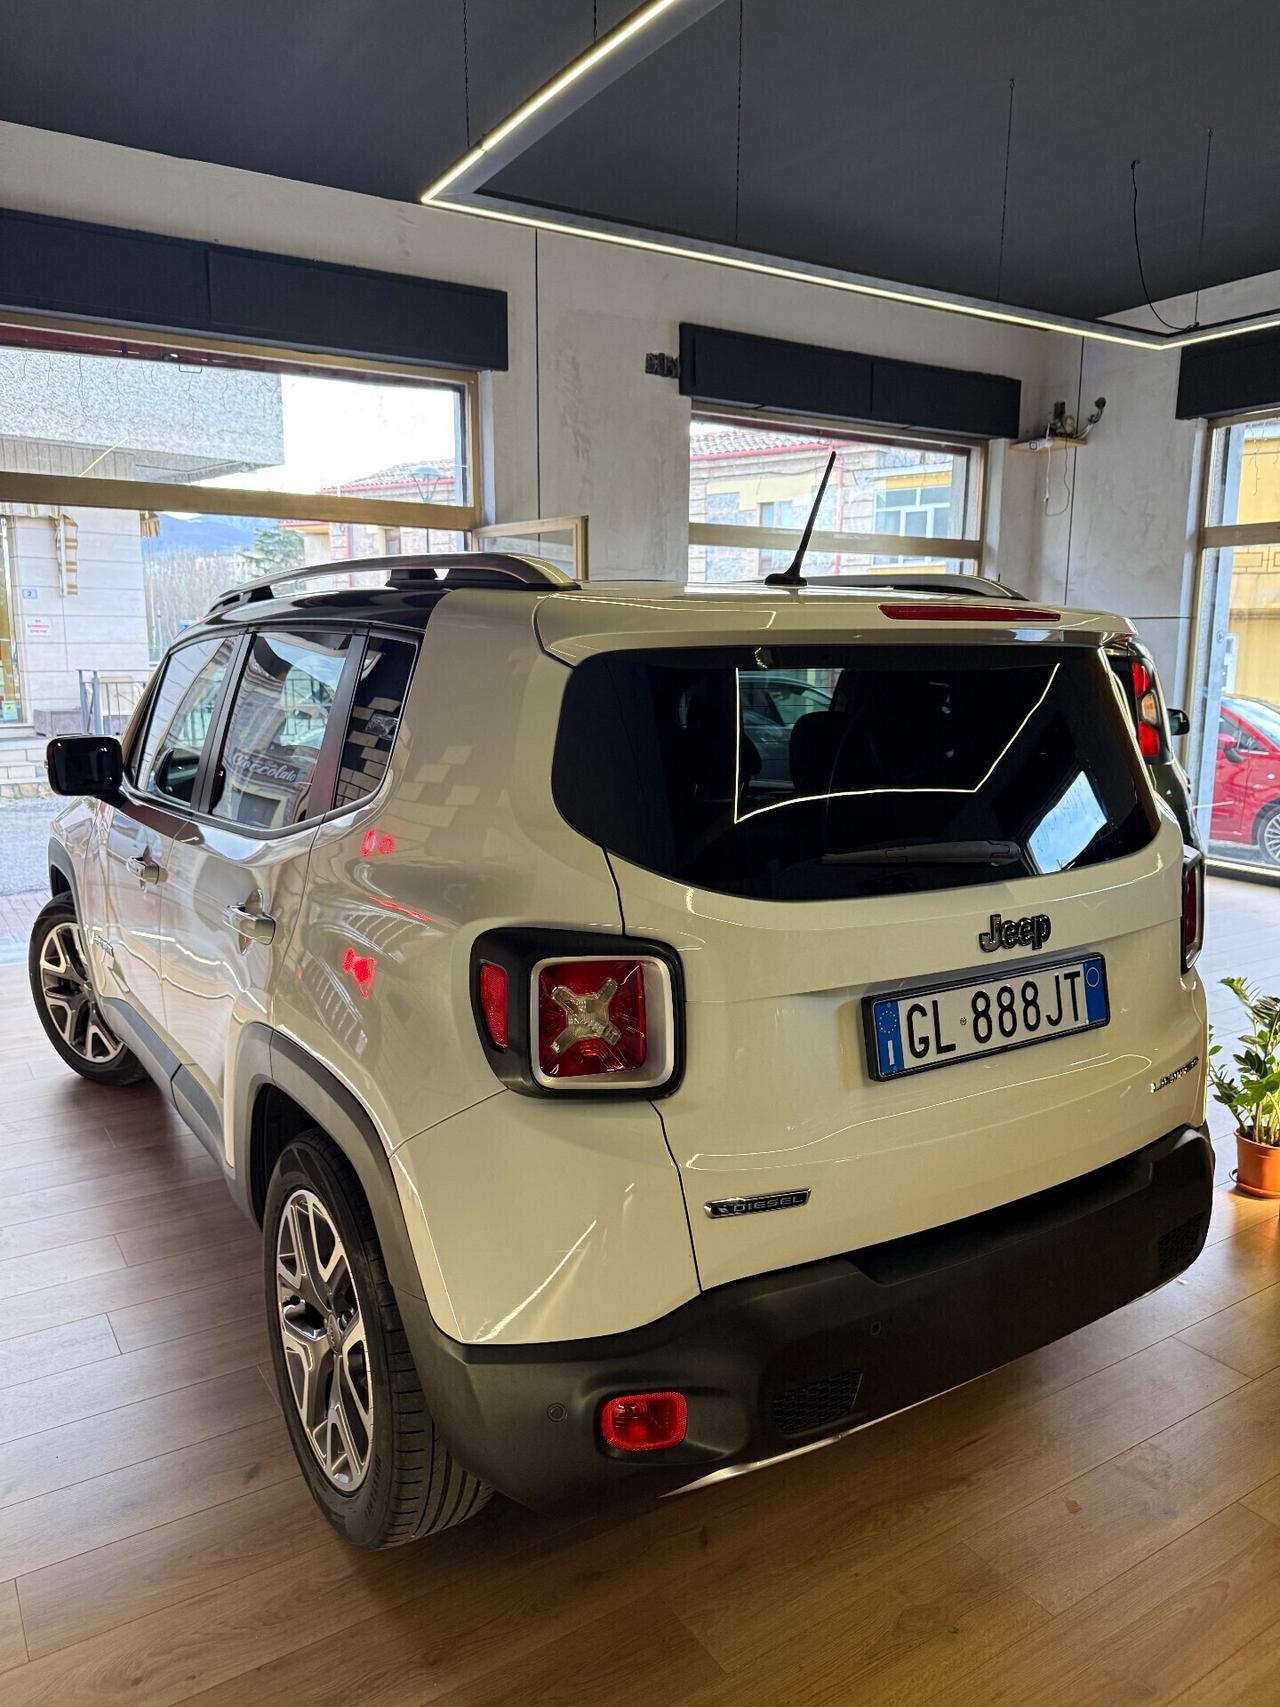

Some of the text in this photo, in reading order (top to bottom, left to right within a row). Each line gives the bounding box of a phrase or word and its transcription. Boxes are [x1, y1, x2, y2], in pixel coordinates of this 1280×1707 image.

[979, 914, 1051, 952] Jeep
[907, 1000, 956, 1059] GL
[733, 1195, 803, 1213] DIESEL
